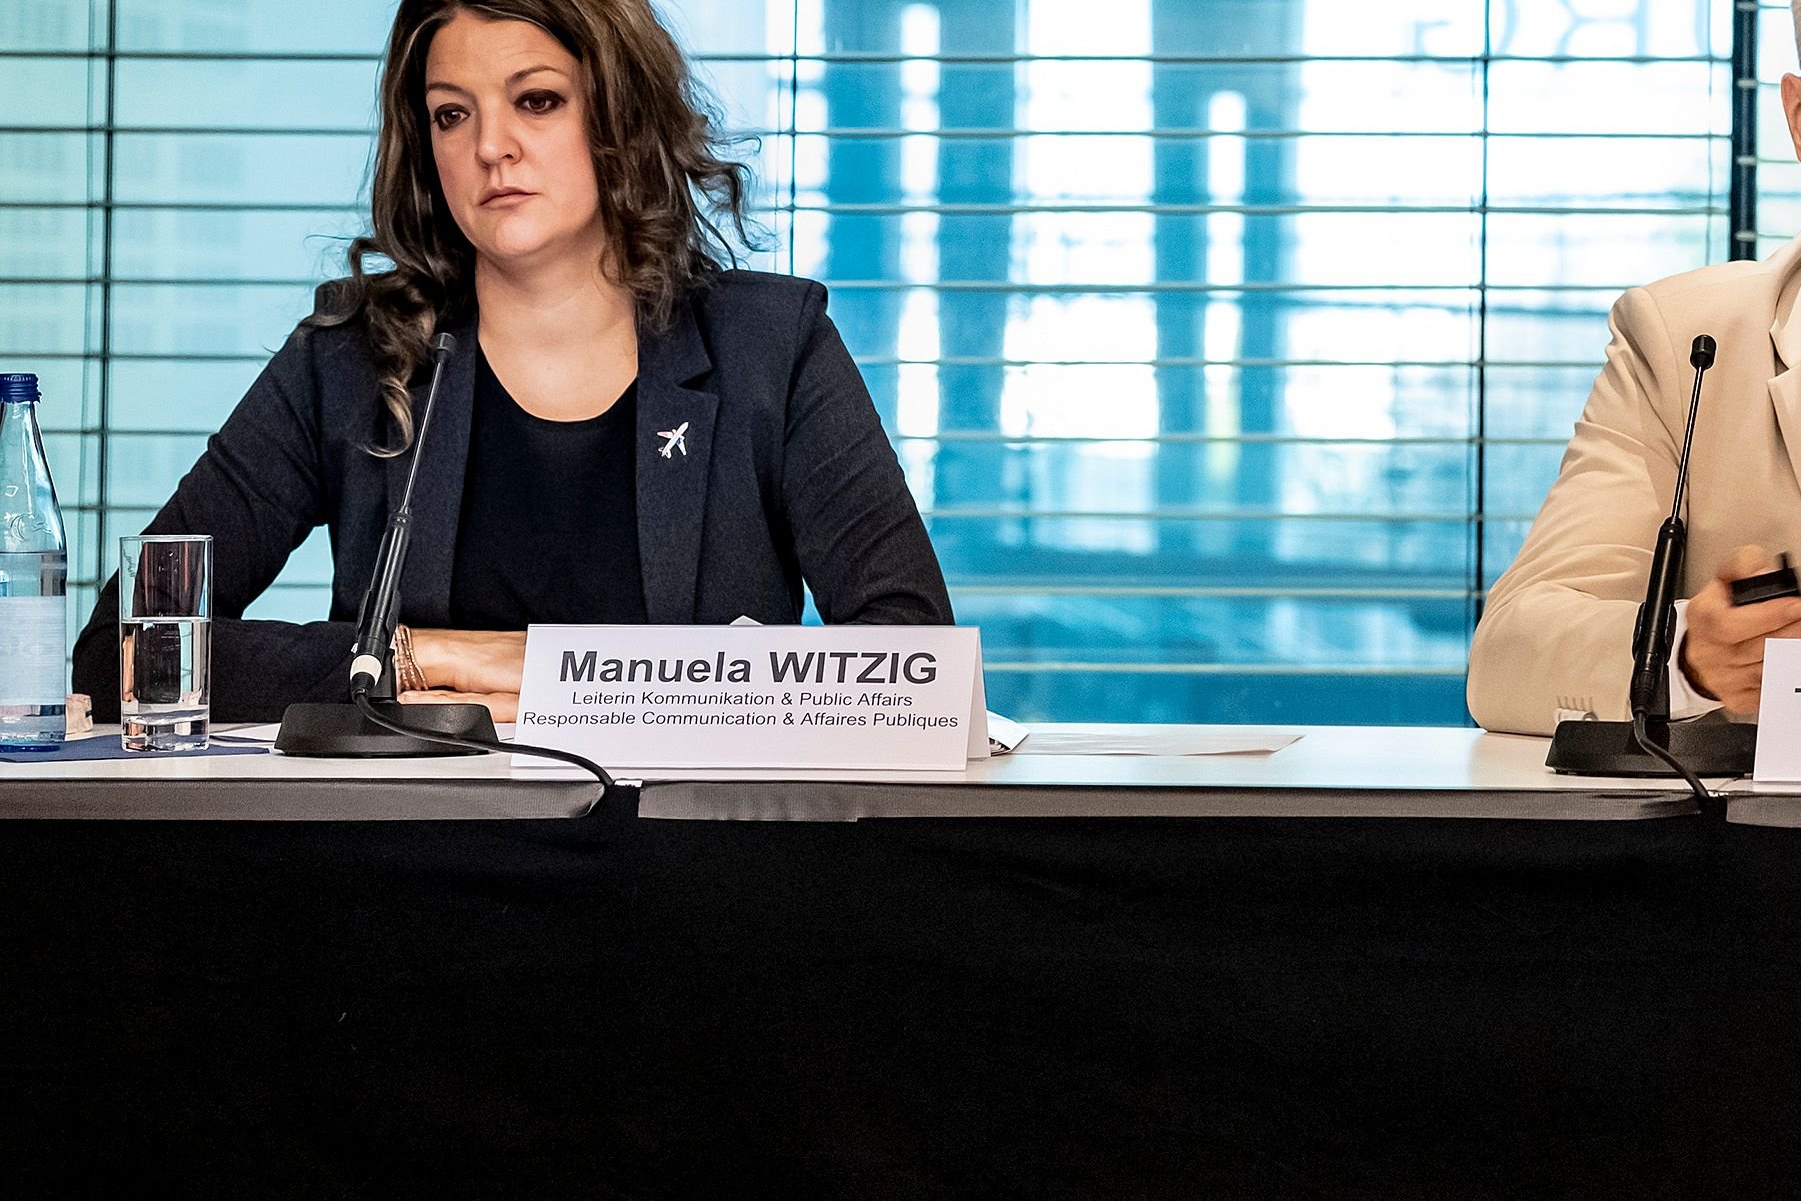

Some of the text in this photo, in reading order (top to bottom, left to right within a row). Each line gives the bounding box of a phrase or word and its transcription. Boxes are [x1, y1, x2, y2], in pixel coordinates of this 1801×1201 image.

[559, 650, 937, 685] Manuela WITZIG
[572, 691, 913, 707] Leiterin Kommunikation & Public Affairs
[523, 711, 959, 731] Responsable Communication & Affaires Publiques
